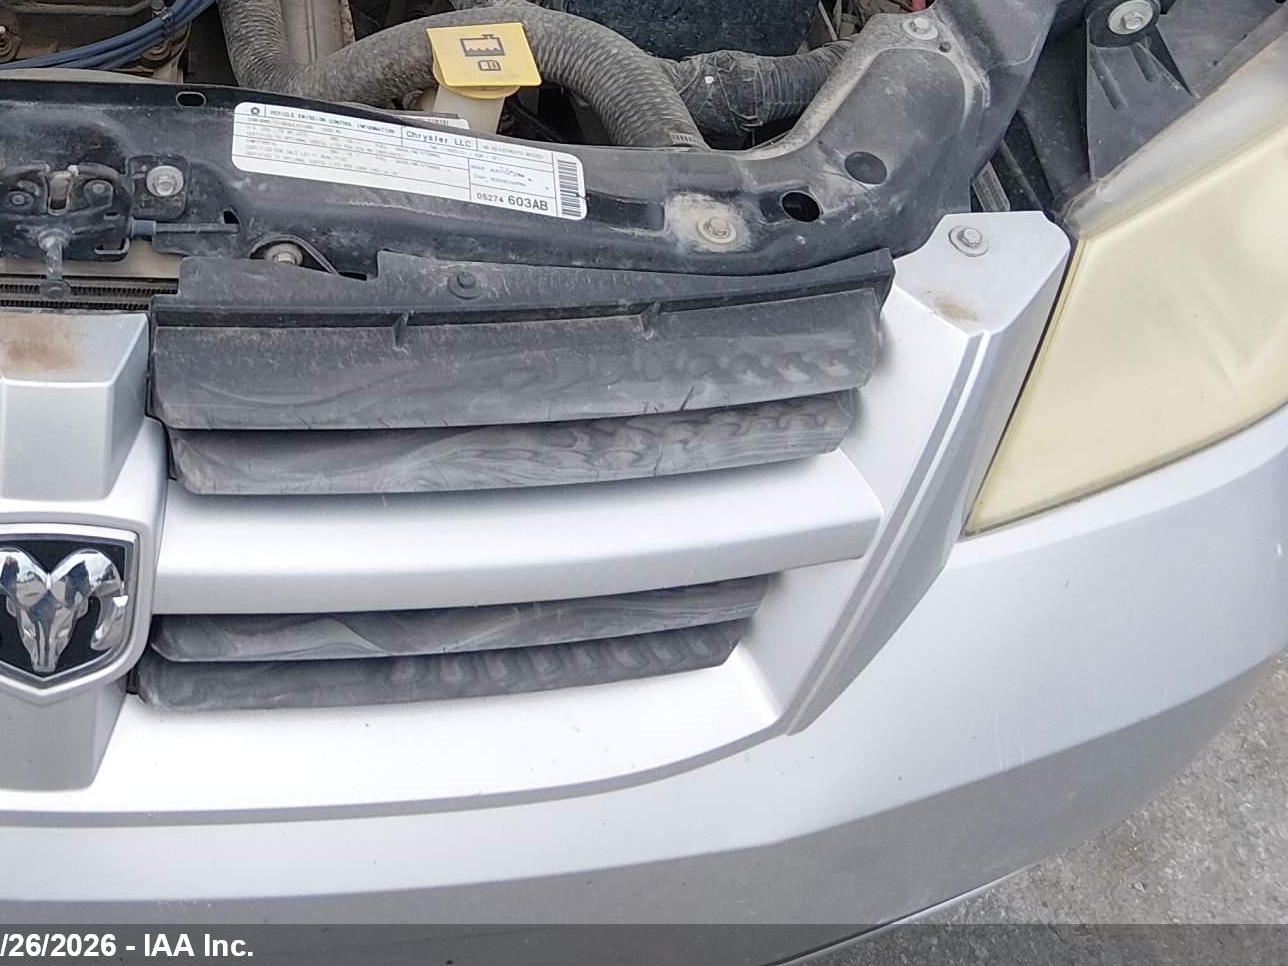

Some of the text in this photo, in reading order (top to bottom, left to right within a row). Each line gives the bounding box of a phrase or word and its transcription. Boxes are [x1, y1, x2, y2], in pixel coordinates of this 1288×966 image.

[270, 109, 295, 118] VEHICLE
[297, 113, 327, 123] EMISSION
[329, 117, 353, 127] CONTROL
[357, 122, 396, 134] INFORMATION
[406, 130, 448, 144] Chrysler
[454, 138, 472, 148] LLC
[476, 192, 549, 211] 05274 603AB
